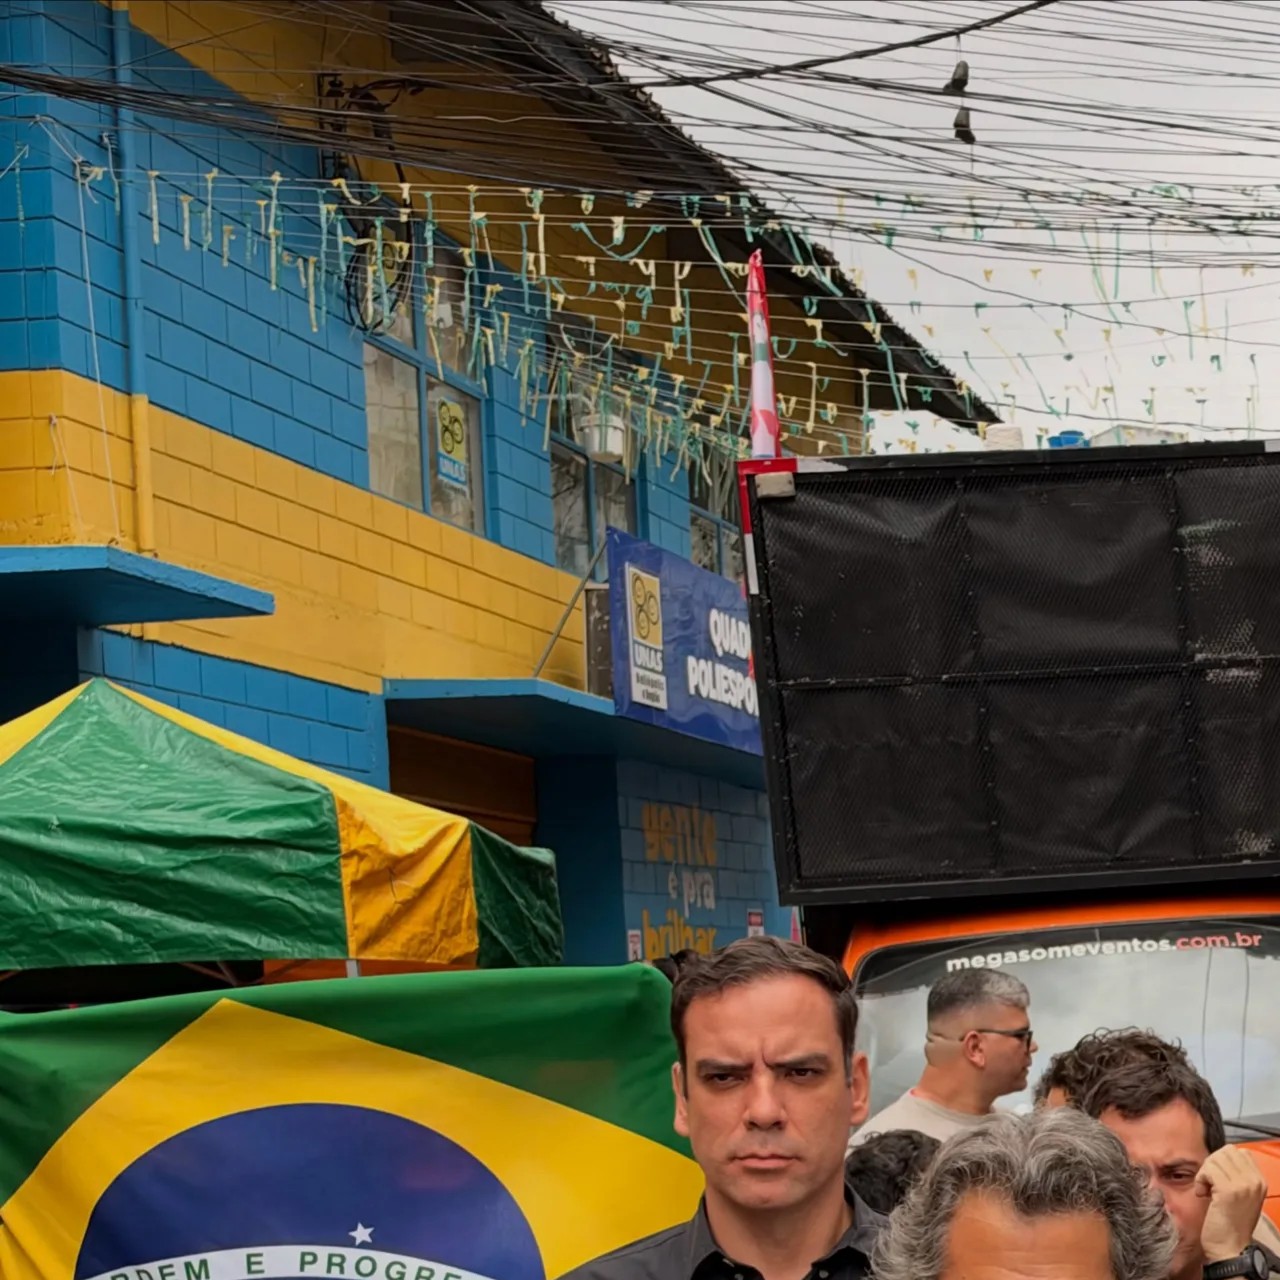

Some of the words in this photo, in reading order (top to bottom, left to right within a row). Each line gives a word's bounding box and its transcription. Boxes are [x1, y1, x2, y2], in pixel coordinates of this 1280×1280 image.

[709, 607, 751, 657] QUAD
[634, 642, 664, 673] UNAS
[687, 655, 760, 717] POLIESPO
[945, 932, 1263, 972] megasomeventos.com.br
[246, 1253, 266, 1275] E
